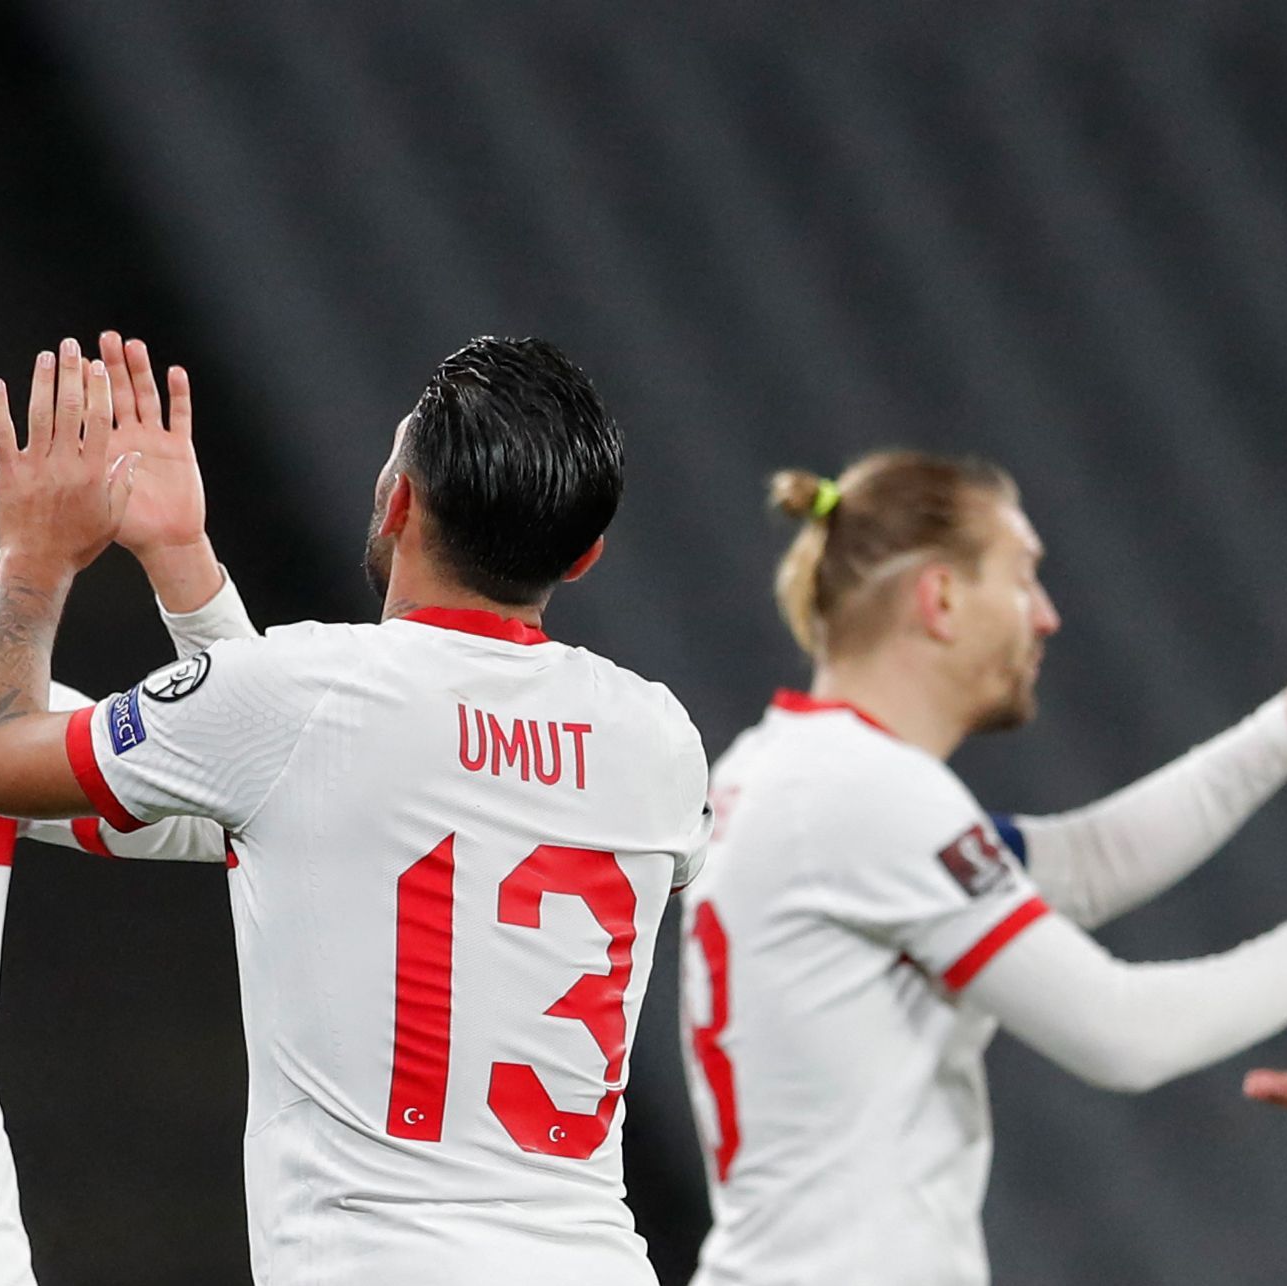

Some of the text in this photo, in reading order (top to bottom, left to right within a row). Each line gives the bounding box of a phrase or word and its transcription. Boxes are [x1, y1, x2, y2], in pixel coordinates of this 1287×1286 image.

[114, 687, 138, 748] SPECT
[458, 703, 592, 790] UMUT
[386, 832, 637, 1160] 13
